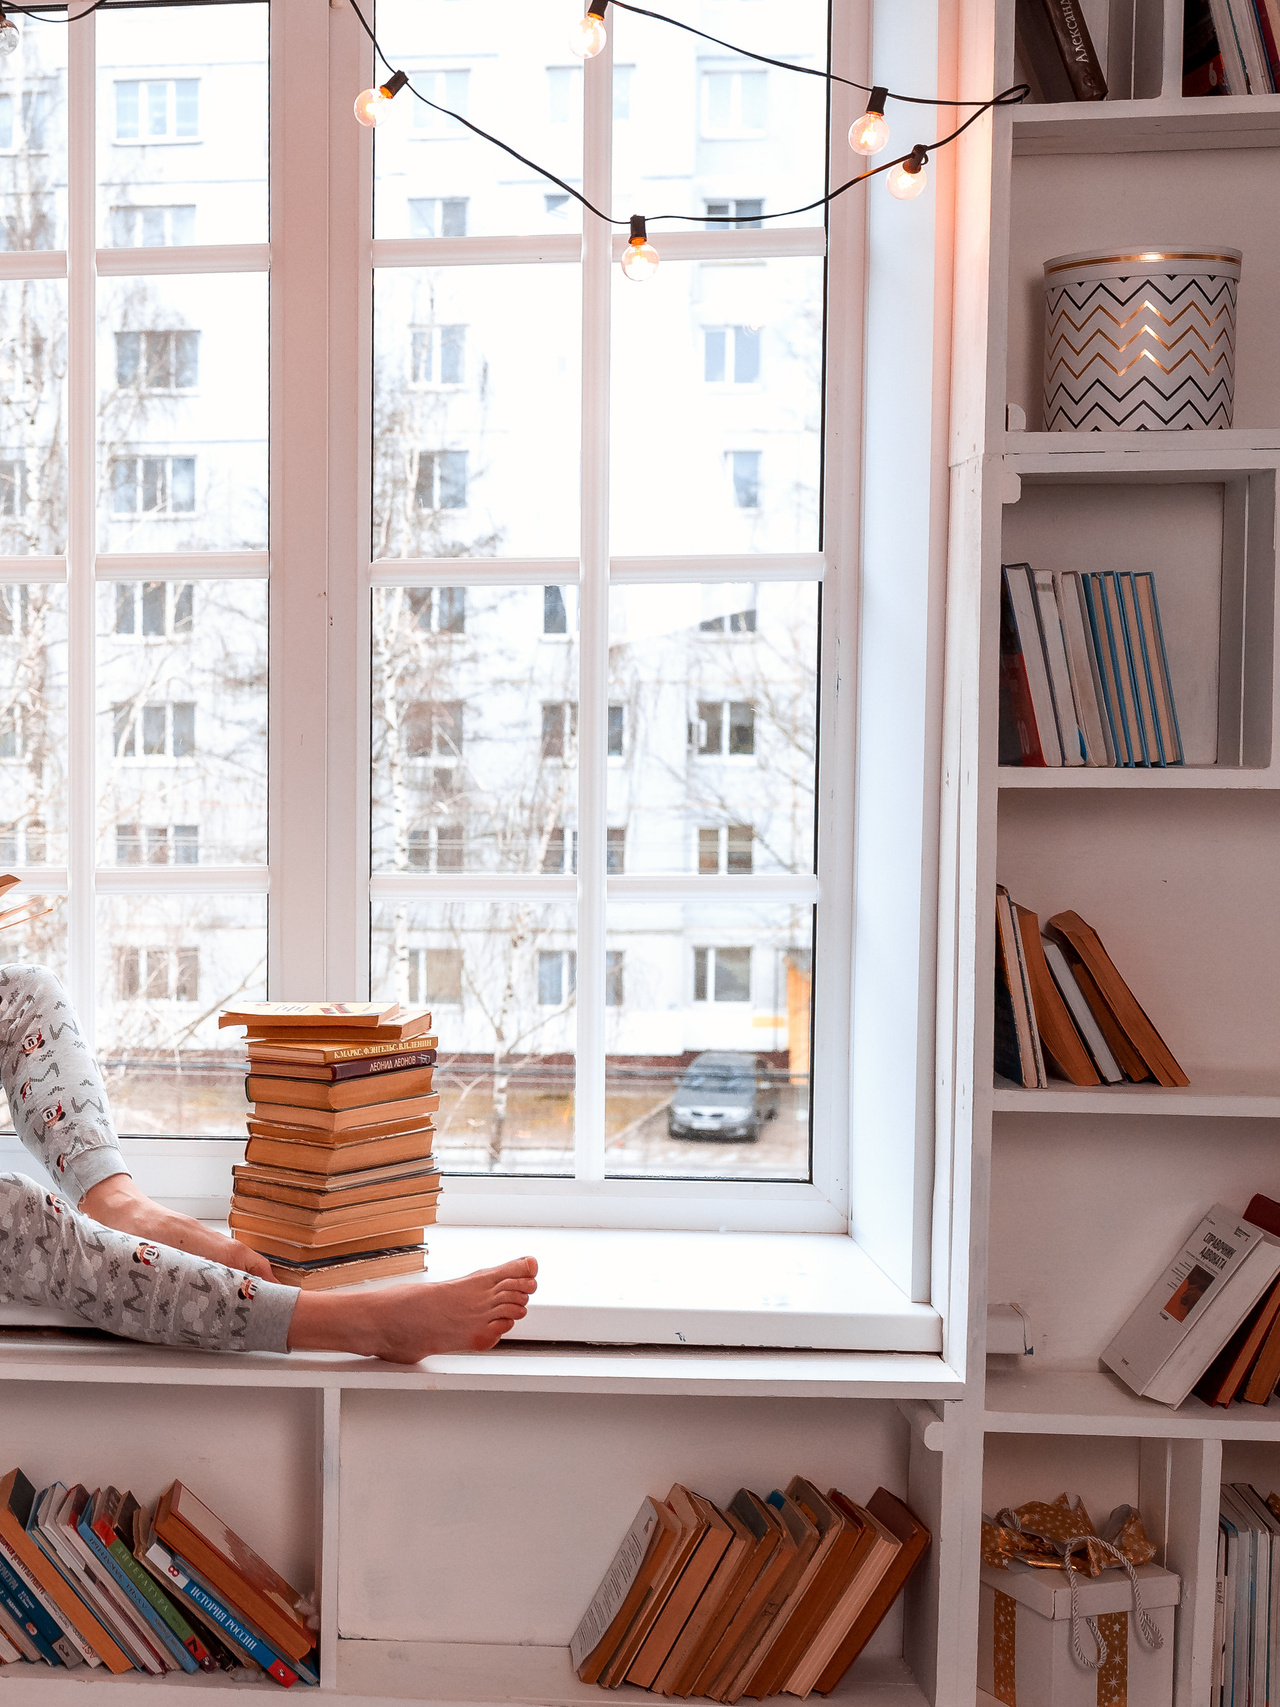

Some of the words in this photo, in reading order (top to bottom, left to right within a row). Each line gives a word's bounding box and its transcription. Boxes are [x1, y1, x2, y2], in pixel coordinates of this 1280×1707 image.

[369, 1061, 393, 1072] ЛЕОНИД
[393, 1056, 417, 1068] ЛЕОНОВ
[89, 1536, 125, 1580] ЗАКАТНЫЕ
[168, 1565, 180, 1577] 8
[118, 1546, 169, 1612] ЛИТЕРАТУРА
[190, 1586, 227, 1622] ИСТОРИЯ
[225, 1619, 258, 1650] РОССИИ
[187, 1638, 199, 1653] 7
